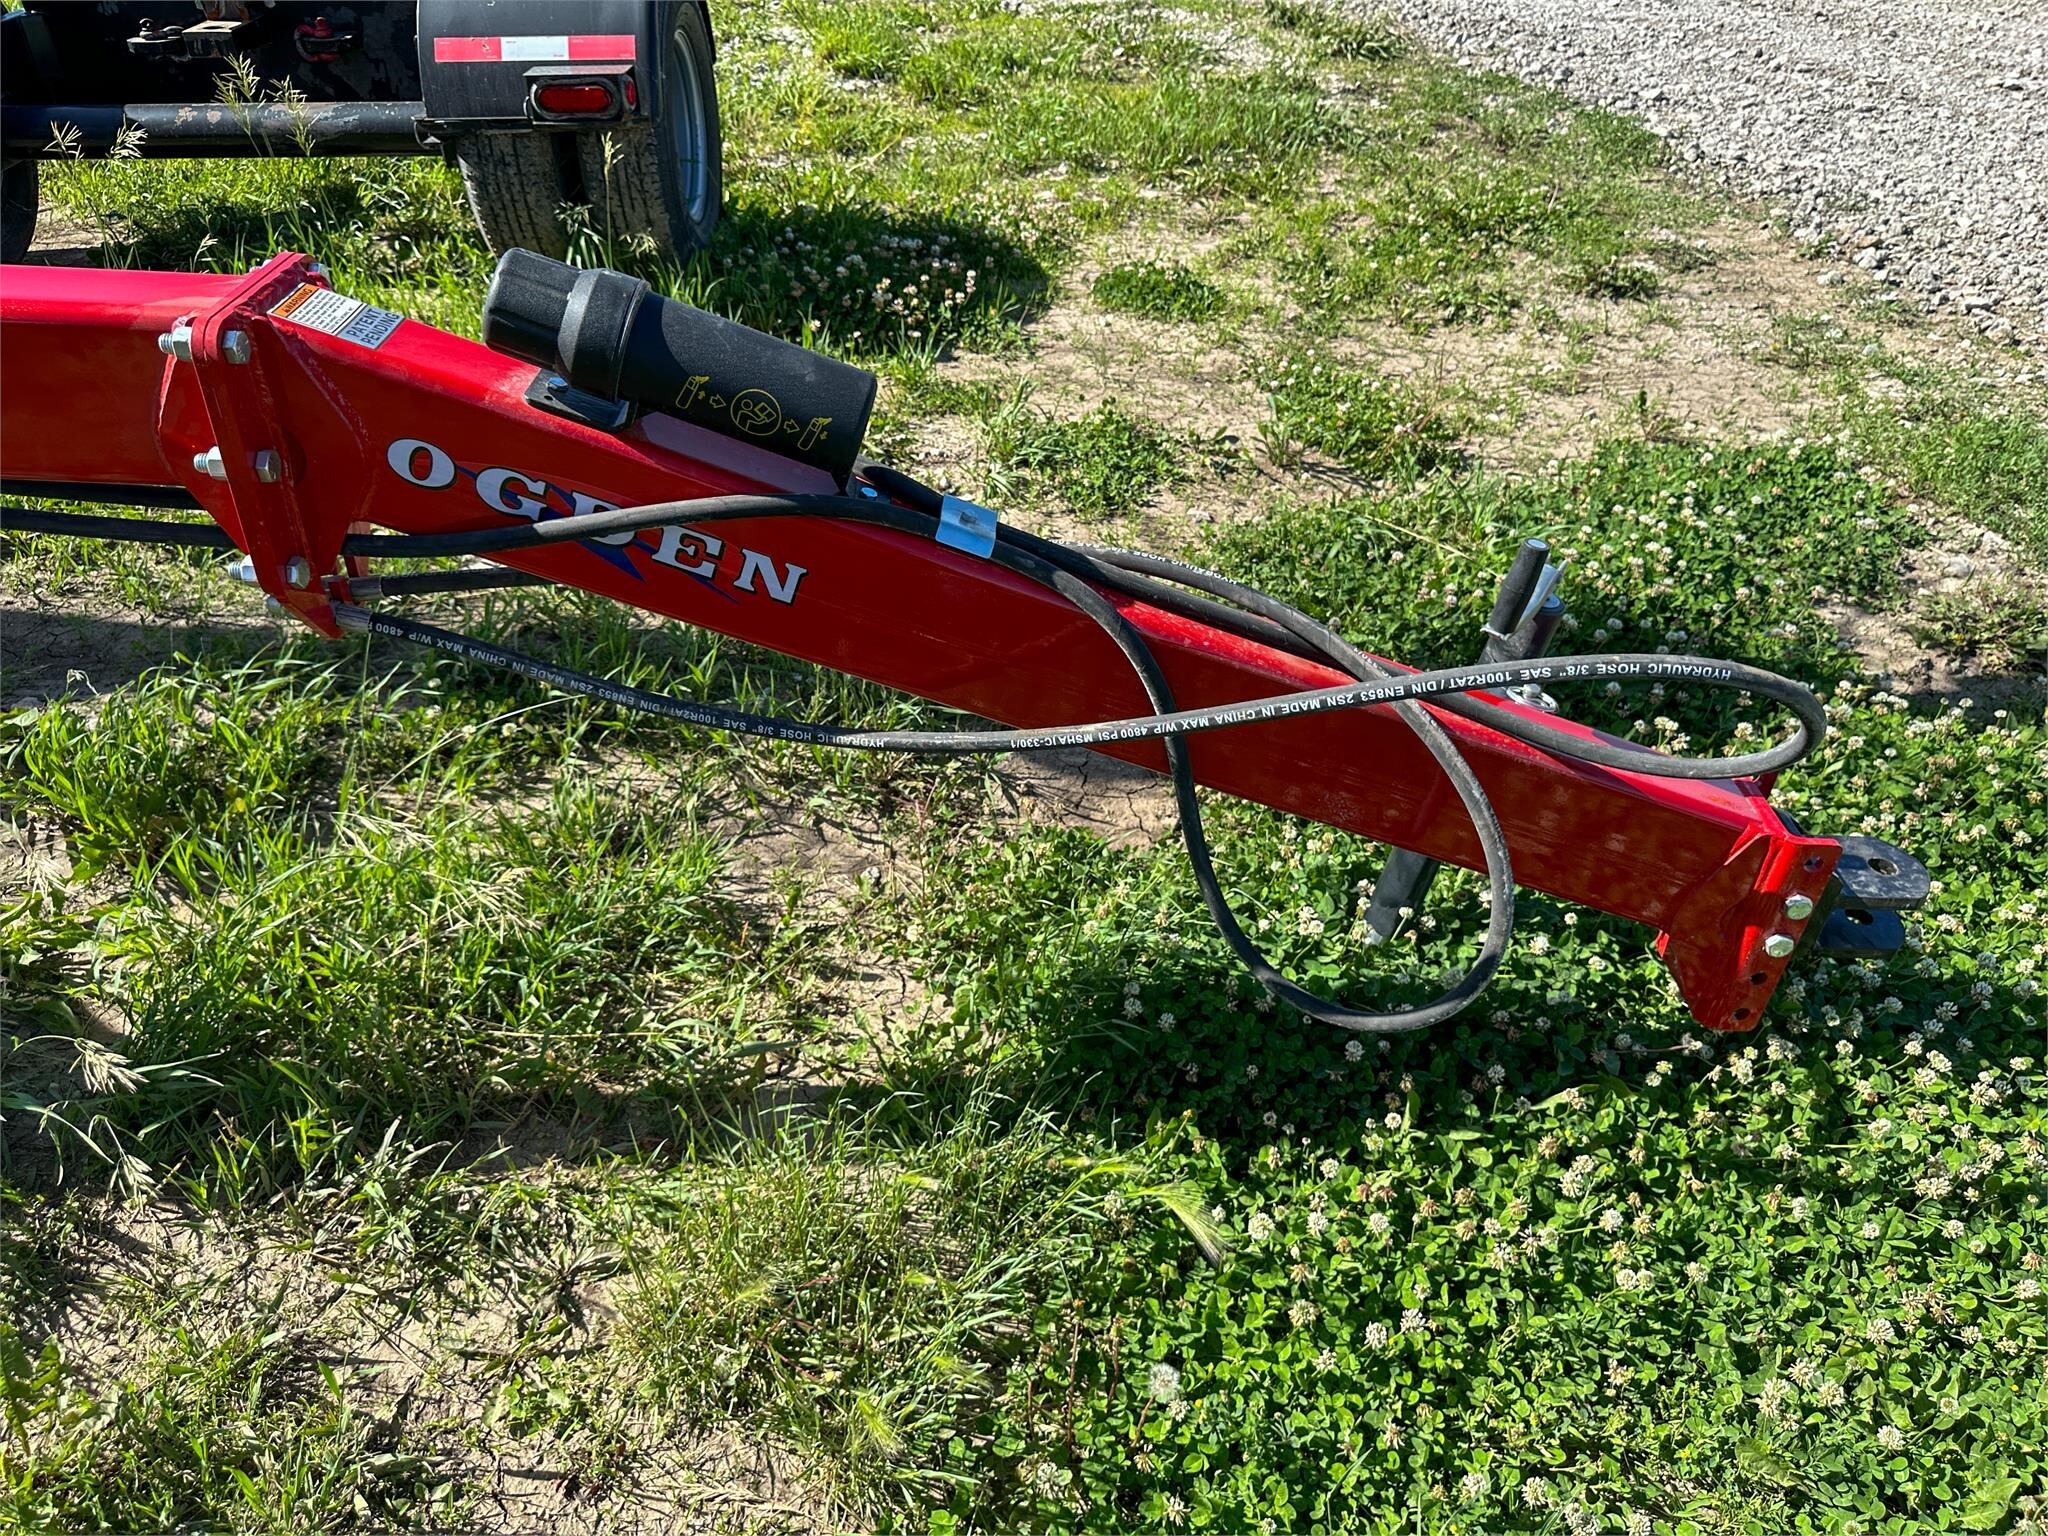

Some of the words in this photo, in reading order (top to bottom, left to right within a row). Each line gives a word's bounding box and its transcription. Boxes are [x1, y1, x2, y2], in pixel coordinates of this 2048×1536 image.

[346, 308, 382, 337] PATENT
[360, 312, 400, 346] PENDING
[375, 623, 404, 637] 4800
[408, 631, 432, 645] W/P
[436, 638, 463, 654] MAX
[469, 647, 507, 667] CHINA
[512, 661, 524, 672] IN
[1519, 667, 1552, 680] SAE
[1559, 664, 1589, 676] 3/8"
[1597, 663, 1640, 675] HOSE
[1647, 662, 1732, 682] HYDRAULIC
[530, 666, 565, 685] MADE
[1449, 671, 1513, 689] 100R2AT
[569, 679, 594, 694] 2SN
[1360, 685, 1405, 702] EN853
[1411, 680, 1437, 694] DIN
[598, 688, 635, 705] EN853
[1327, 692, 1354, 707] 2SN
[639, 699, 661, 712] DIN
[1262, 704, 1275, 718] IN
[1281, 699, 1320, 714] MADE
[670, 707, 717, 726] 100R2AT
[722, 717, 747, 731] SAE
[1181, 716, 1210, 731] MAX
[1214, 709, 1256, 724] CHINA
[751, 724, 774, 736] 3/8"
[779, 728, 812, 741] HOSE
[1120, 726, 1148, 739] 4800
[1153, 722, 1178, 734] W/P
[816, 732, 886, 749] HYDRAULIC
[1098, 731, 1118, 742] PSI
